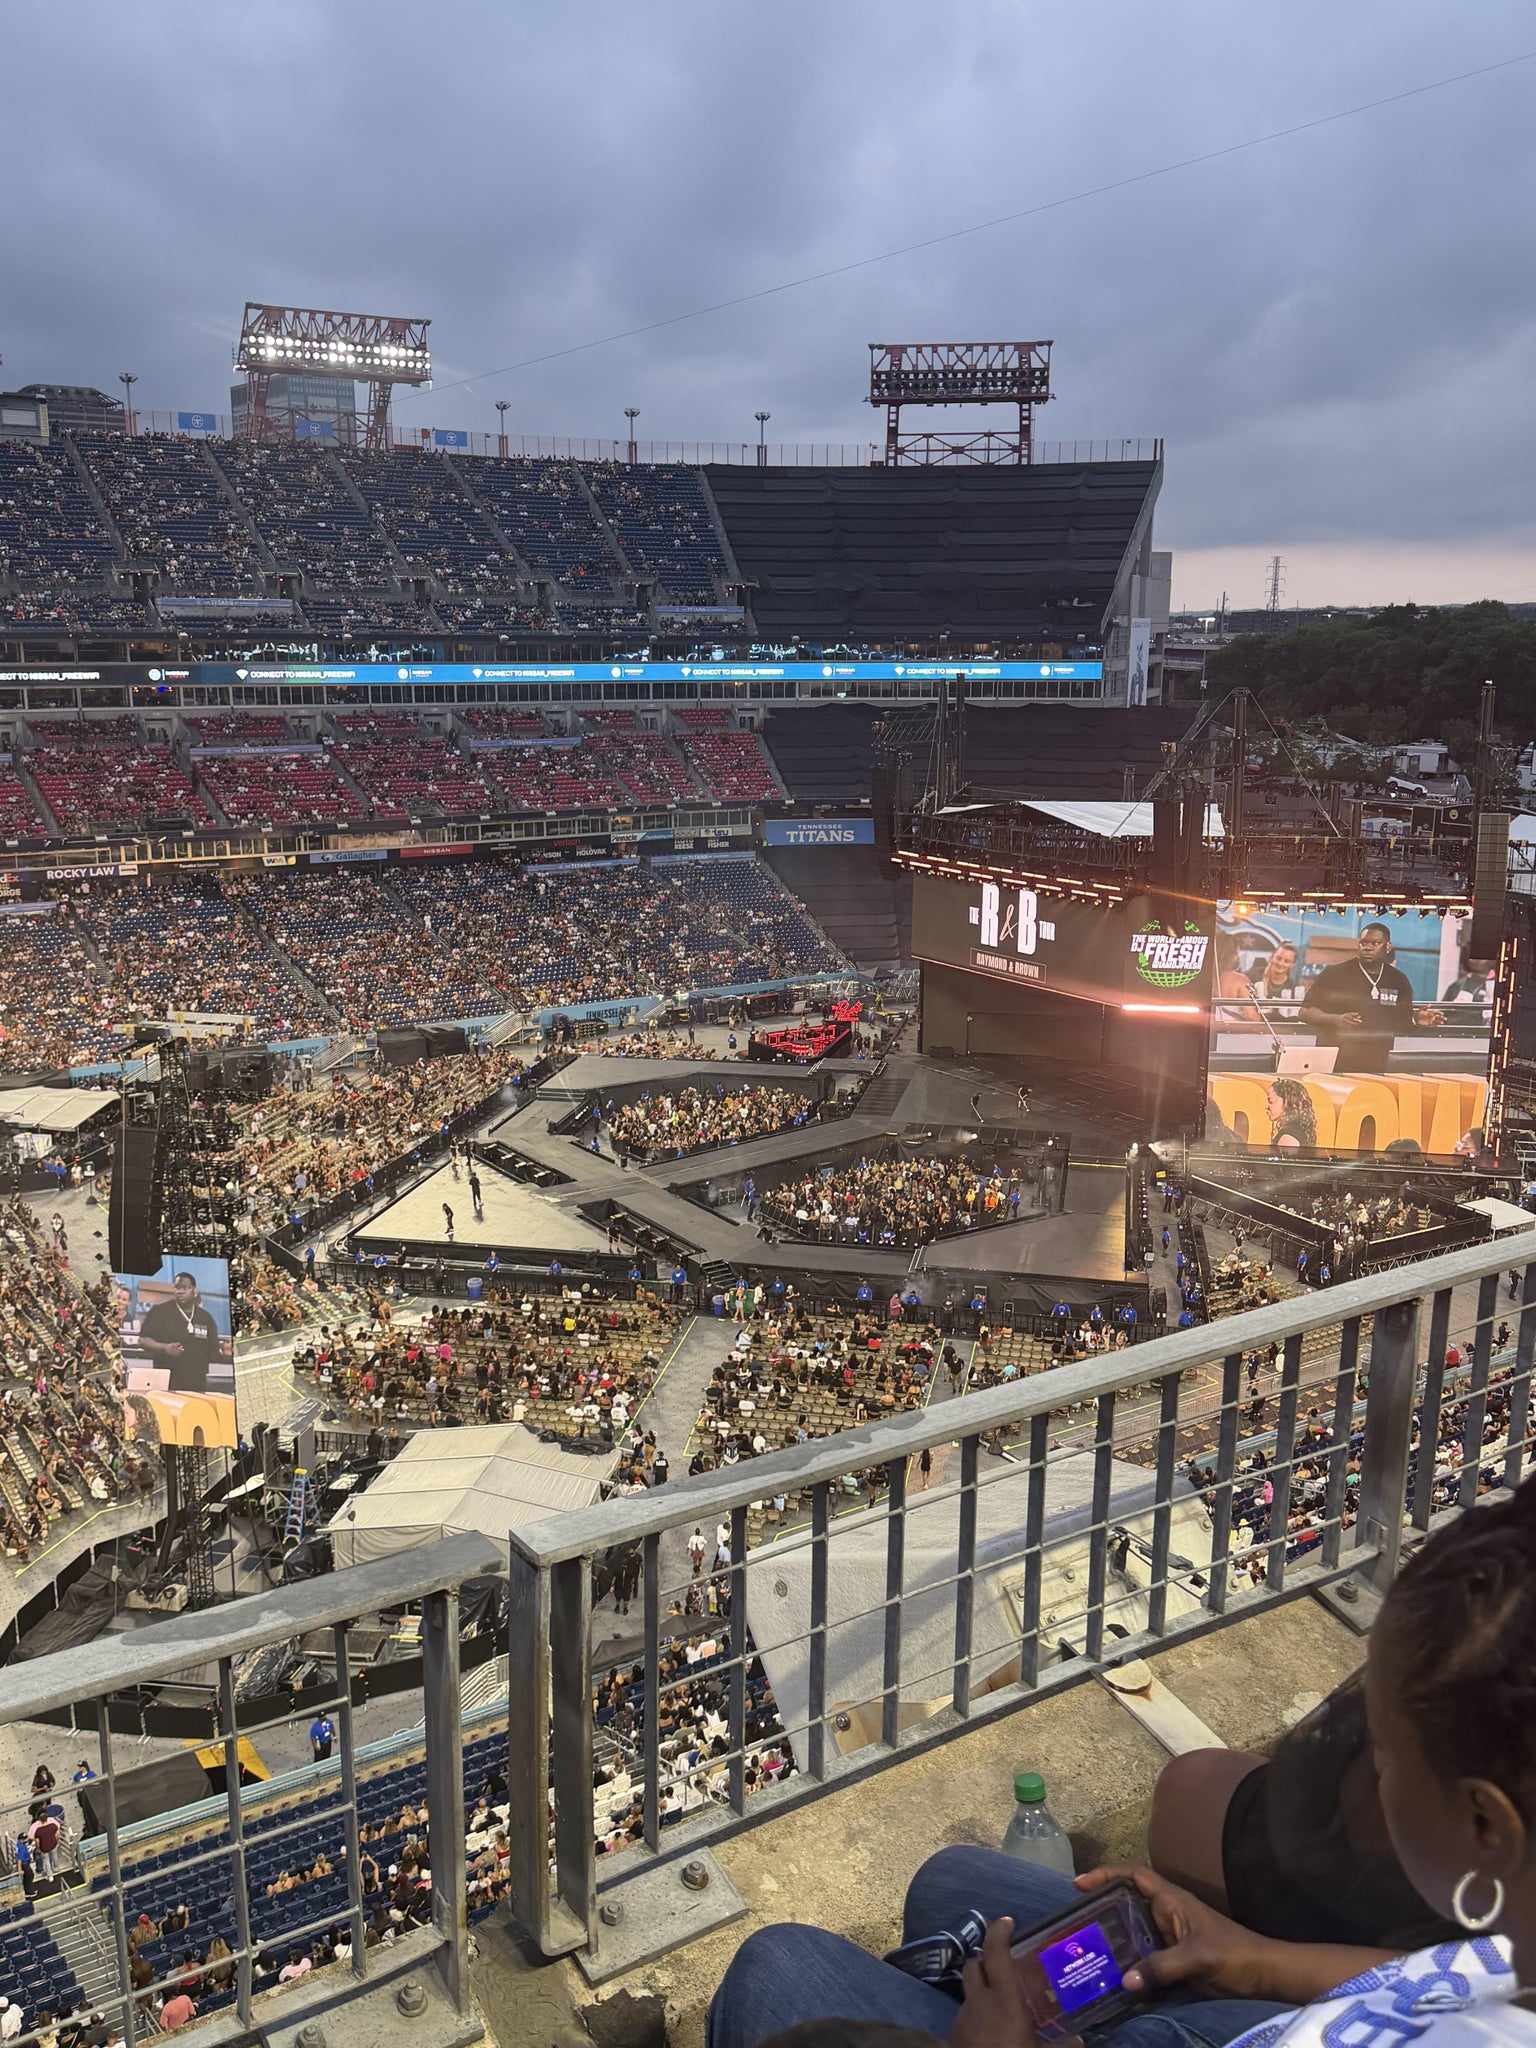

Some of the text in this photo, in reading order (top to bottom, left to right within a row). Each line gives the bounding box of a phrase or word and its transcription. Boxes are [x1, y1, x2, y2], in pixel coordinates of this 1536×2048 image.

[612, 834, 638, 843] Pinnacle
[786, 830, 855, 843] TITANS
[674, 842, 694, 850] REESE
[707, 841, 730, 849] FISHER
[336, 851, 377, 861] Gallagher
[47, 866, 115, 880] ROCKY LAW
[1039, 920, 1056, 941] TOUR
[1131, 934, 1209, 945] THE WORLD FAMOUS
[1130, 943, 1207, 964] DJ FRESH
[976, 953, 1008, 971] RAYMOND
[1015, 961, 1039, 979] BROWN
